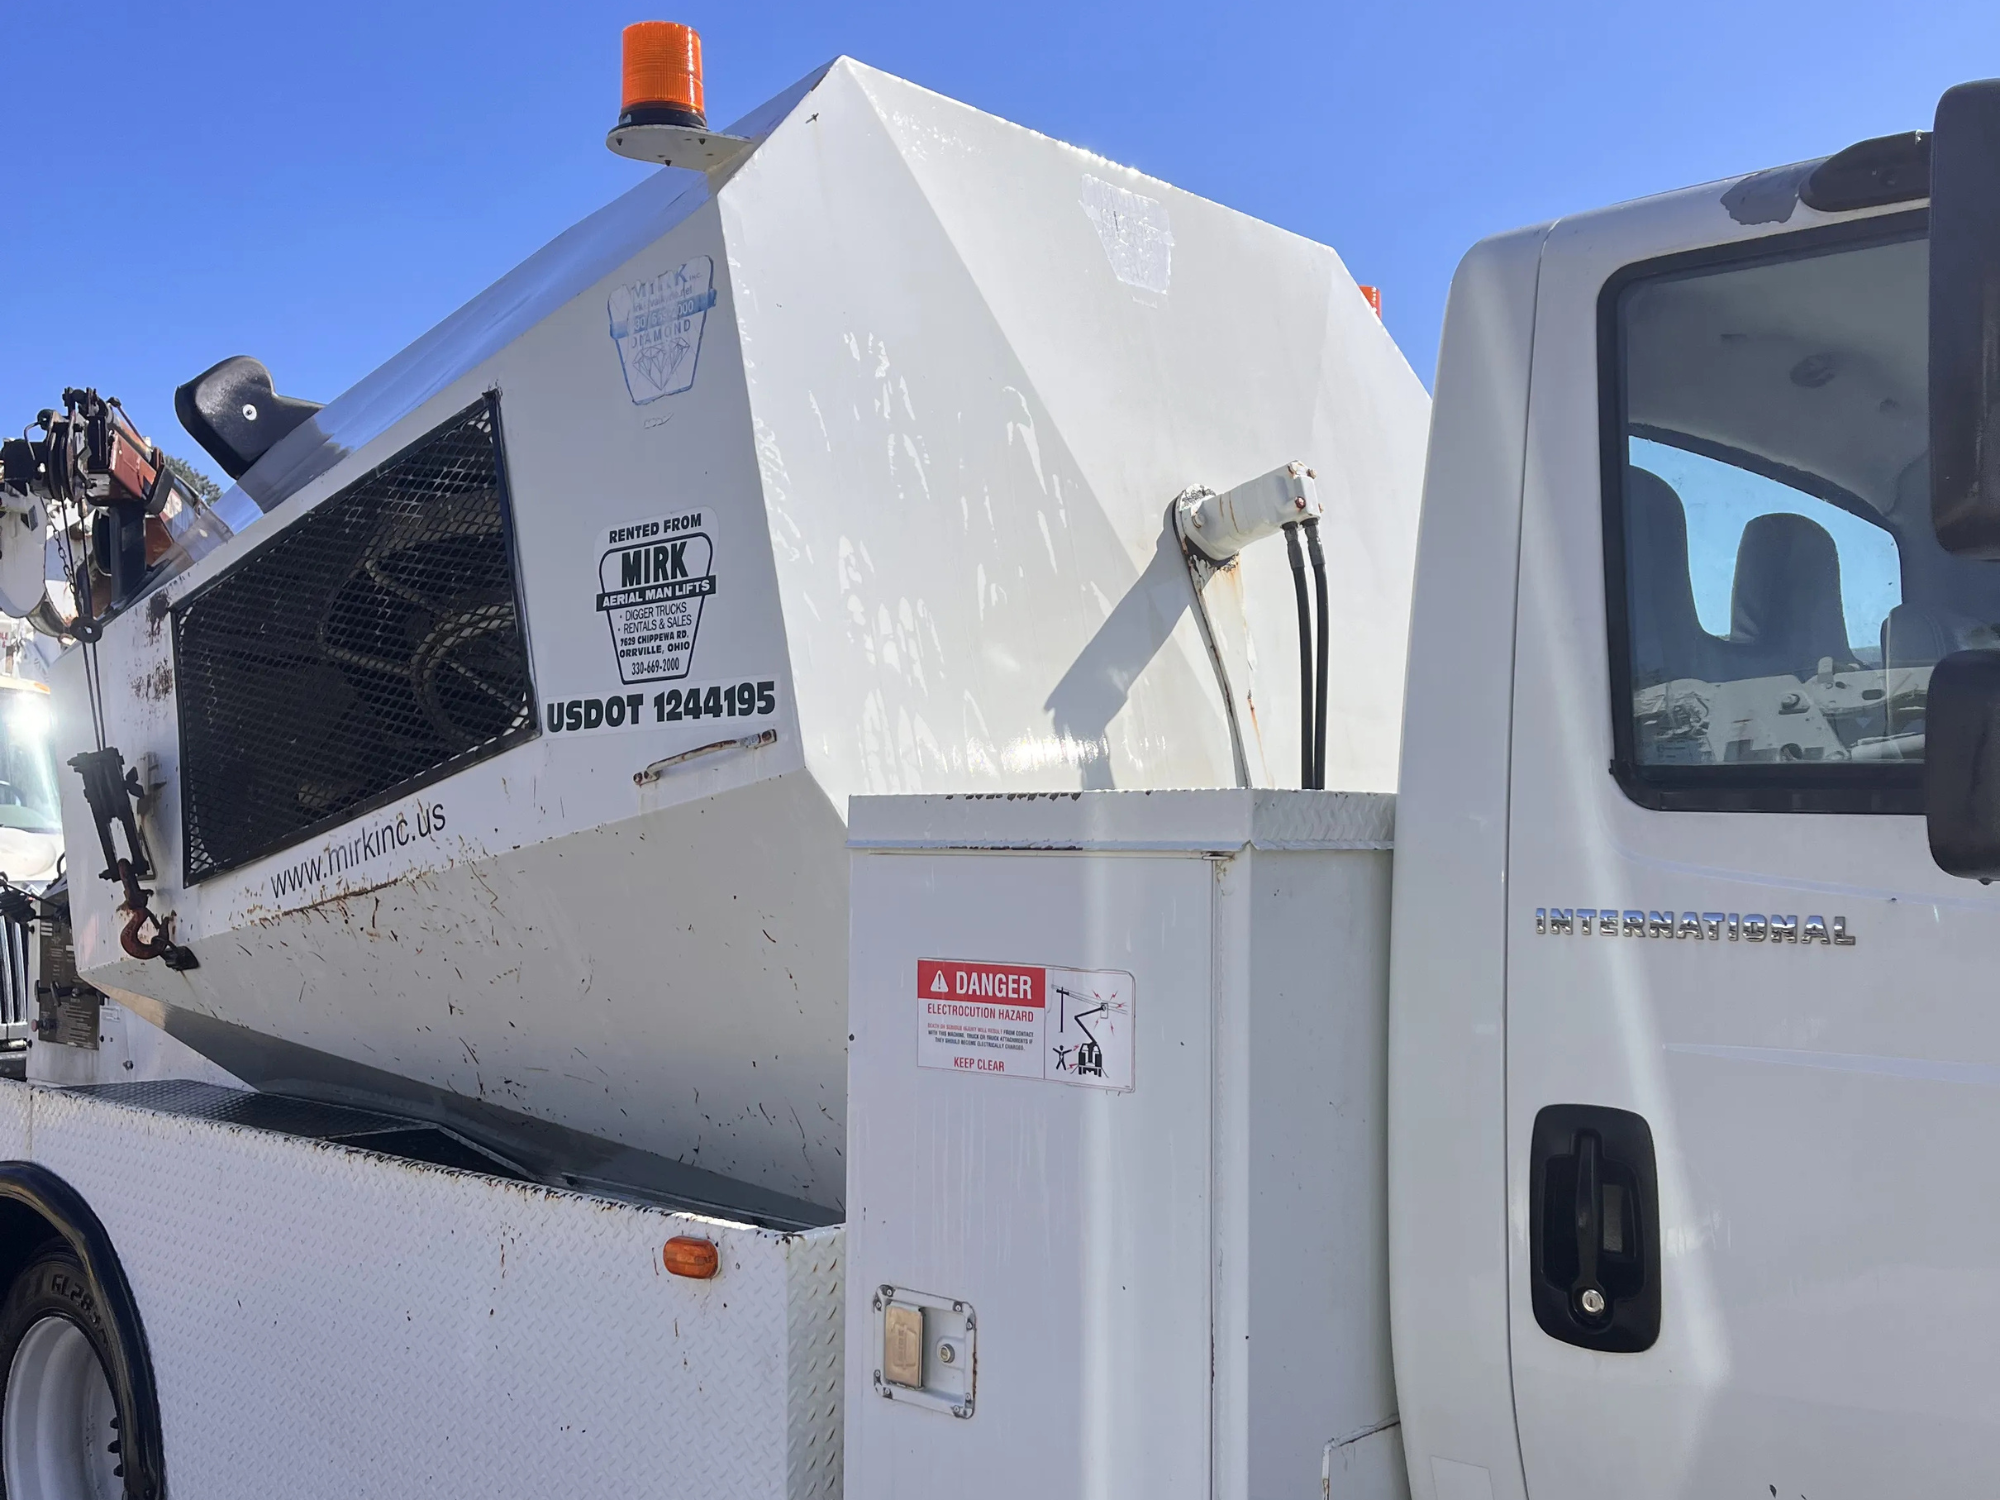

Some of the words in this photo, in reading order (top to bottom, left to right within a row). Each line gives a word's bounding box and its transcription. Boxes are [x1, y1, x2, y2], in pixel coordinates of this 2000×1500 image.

[609, 521, 660, 544] RENTED
[663, 513, 702, 534] FROM
[621, 541, 689, 588] MIRK
[602, 591, 643, 607] AERIAL
[645, 586, 672, 601] MAN
[675, 579, 710, 596] LIFTS
[625, 607, 654, 621] DIGGER
[655, 601, 687, 617] TRUCKS
[623, 619, 657, 634] RENTALS
[658, 618, 665, 629] &
[667, 614, 692, 628] SALES
[619, 645, 665, 658] ORRVILLE,
[667, 641, 690, 652] OHIO
[620, 636, 636, 646] 7629
[637, 631, 674, 644] CHIPPEWA
[676, 630, 689, 640] RD.
[631, 657, 680, 675] 330-669-2000
[546, 693, 643, 733] USDOT
[653, 681, 776, 723] 1244195
[270, 803, 446, 898] www.mirkinc.us
[1535, 907, 1856, 945] INTERNATIONAL
[956, 970, 1032, 1000] DANGER
[927, 1003, 996, 1019] ELECTROCUTION
[998, 1010, 1034, 1023] HAZARD
[953, 1056, 975, 1070] KEEP
[977, 1059, 1005, 1072] CLEAR
